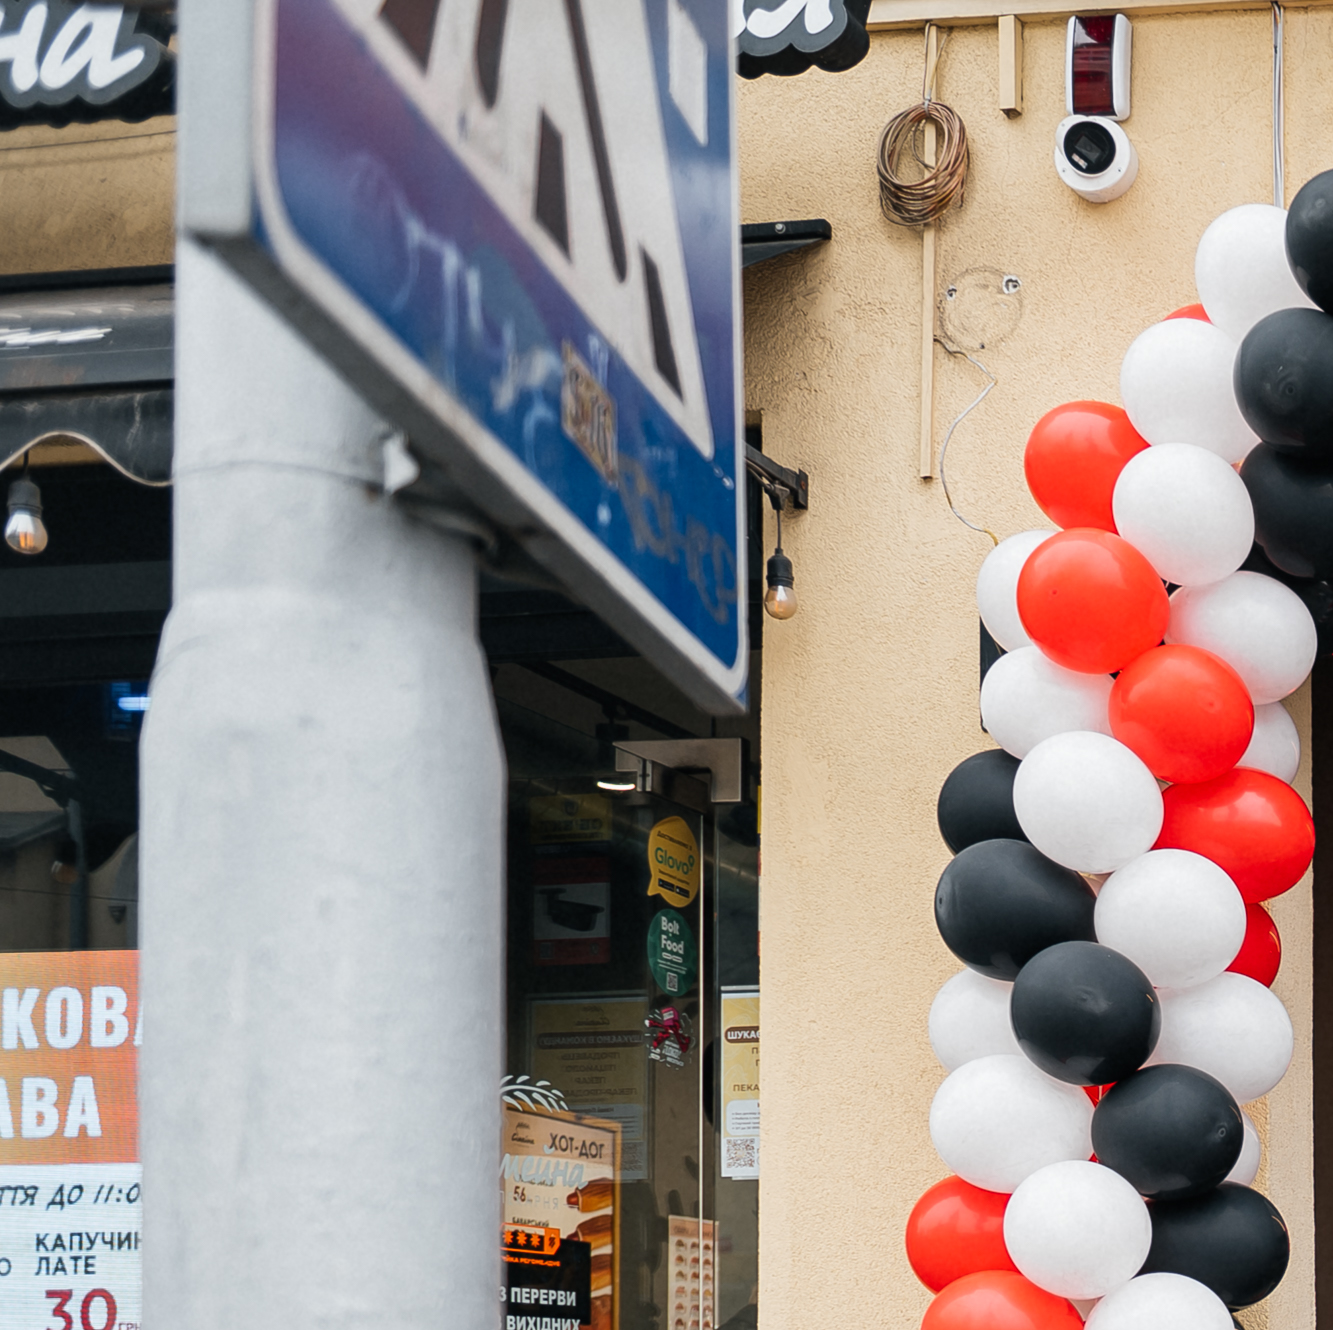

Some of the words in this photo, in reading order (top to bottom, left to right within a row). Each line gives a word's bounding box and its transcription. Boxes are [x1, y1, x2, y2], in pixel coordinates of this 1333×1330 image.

[655, 847, 689, 875] Glovo
[661, 916, 680, 935] Bolt
[661, 934, 685, 955] Food
[35, 1255, 96, 1276] ЛАТЕ
[511, 1287, 577, 1307] ПЕРЕРВИ
